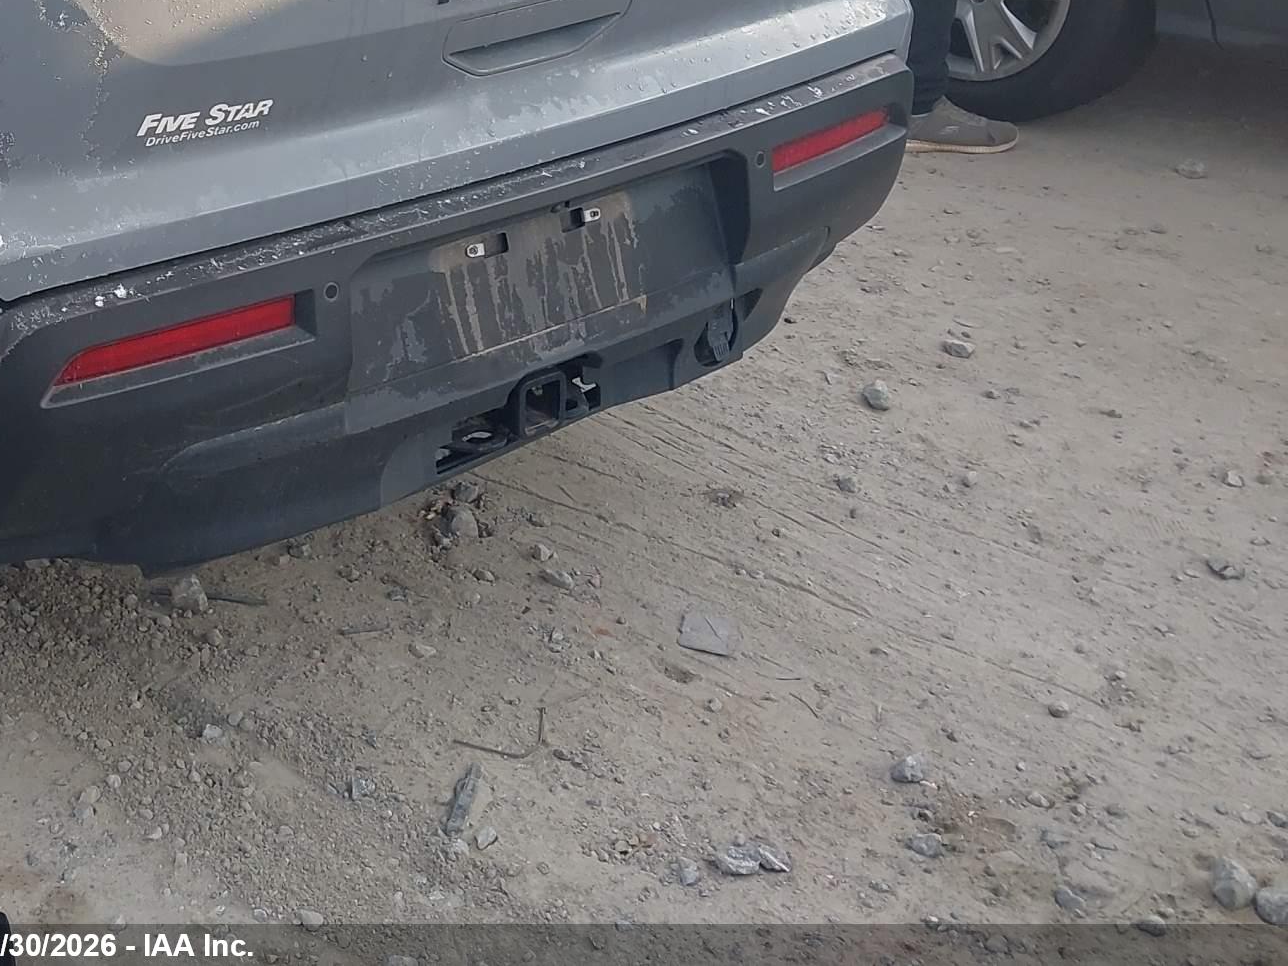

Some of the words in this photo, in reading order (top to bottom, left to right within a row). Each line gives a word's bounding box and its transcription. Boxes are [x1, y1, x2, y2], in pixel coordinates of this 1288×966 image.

[137, 112, 201, 137] FIVE
[205, 99, 274, 126] STAR
[145, 120, 260, 147] DriveFiveStar.com
